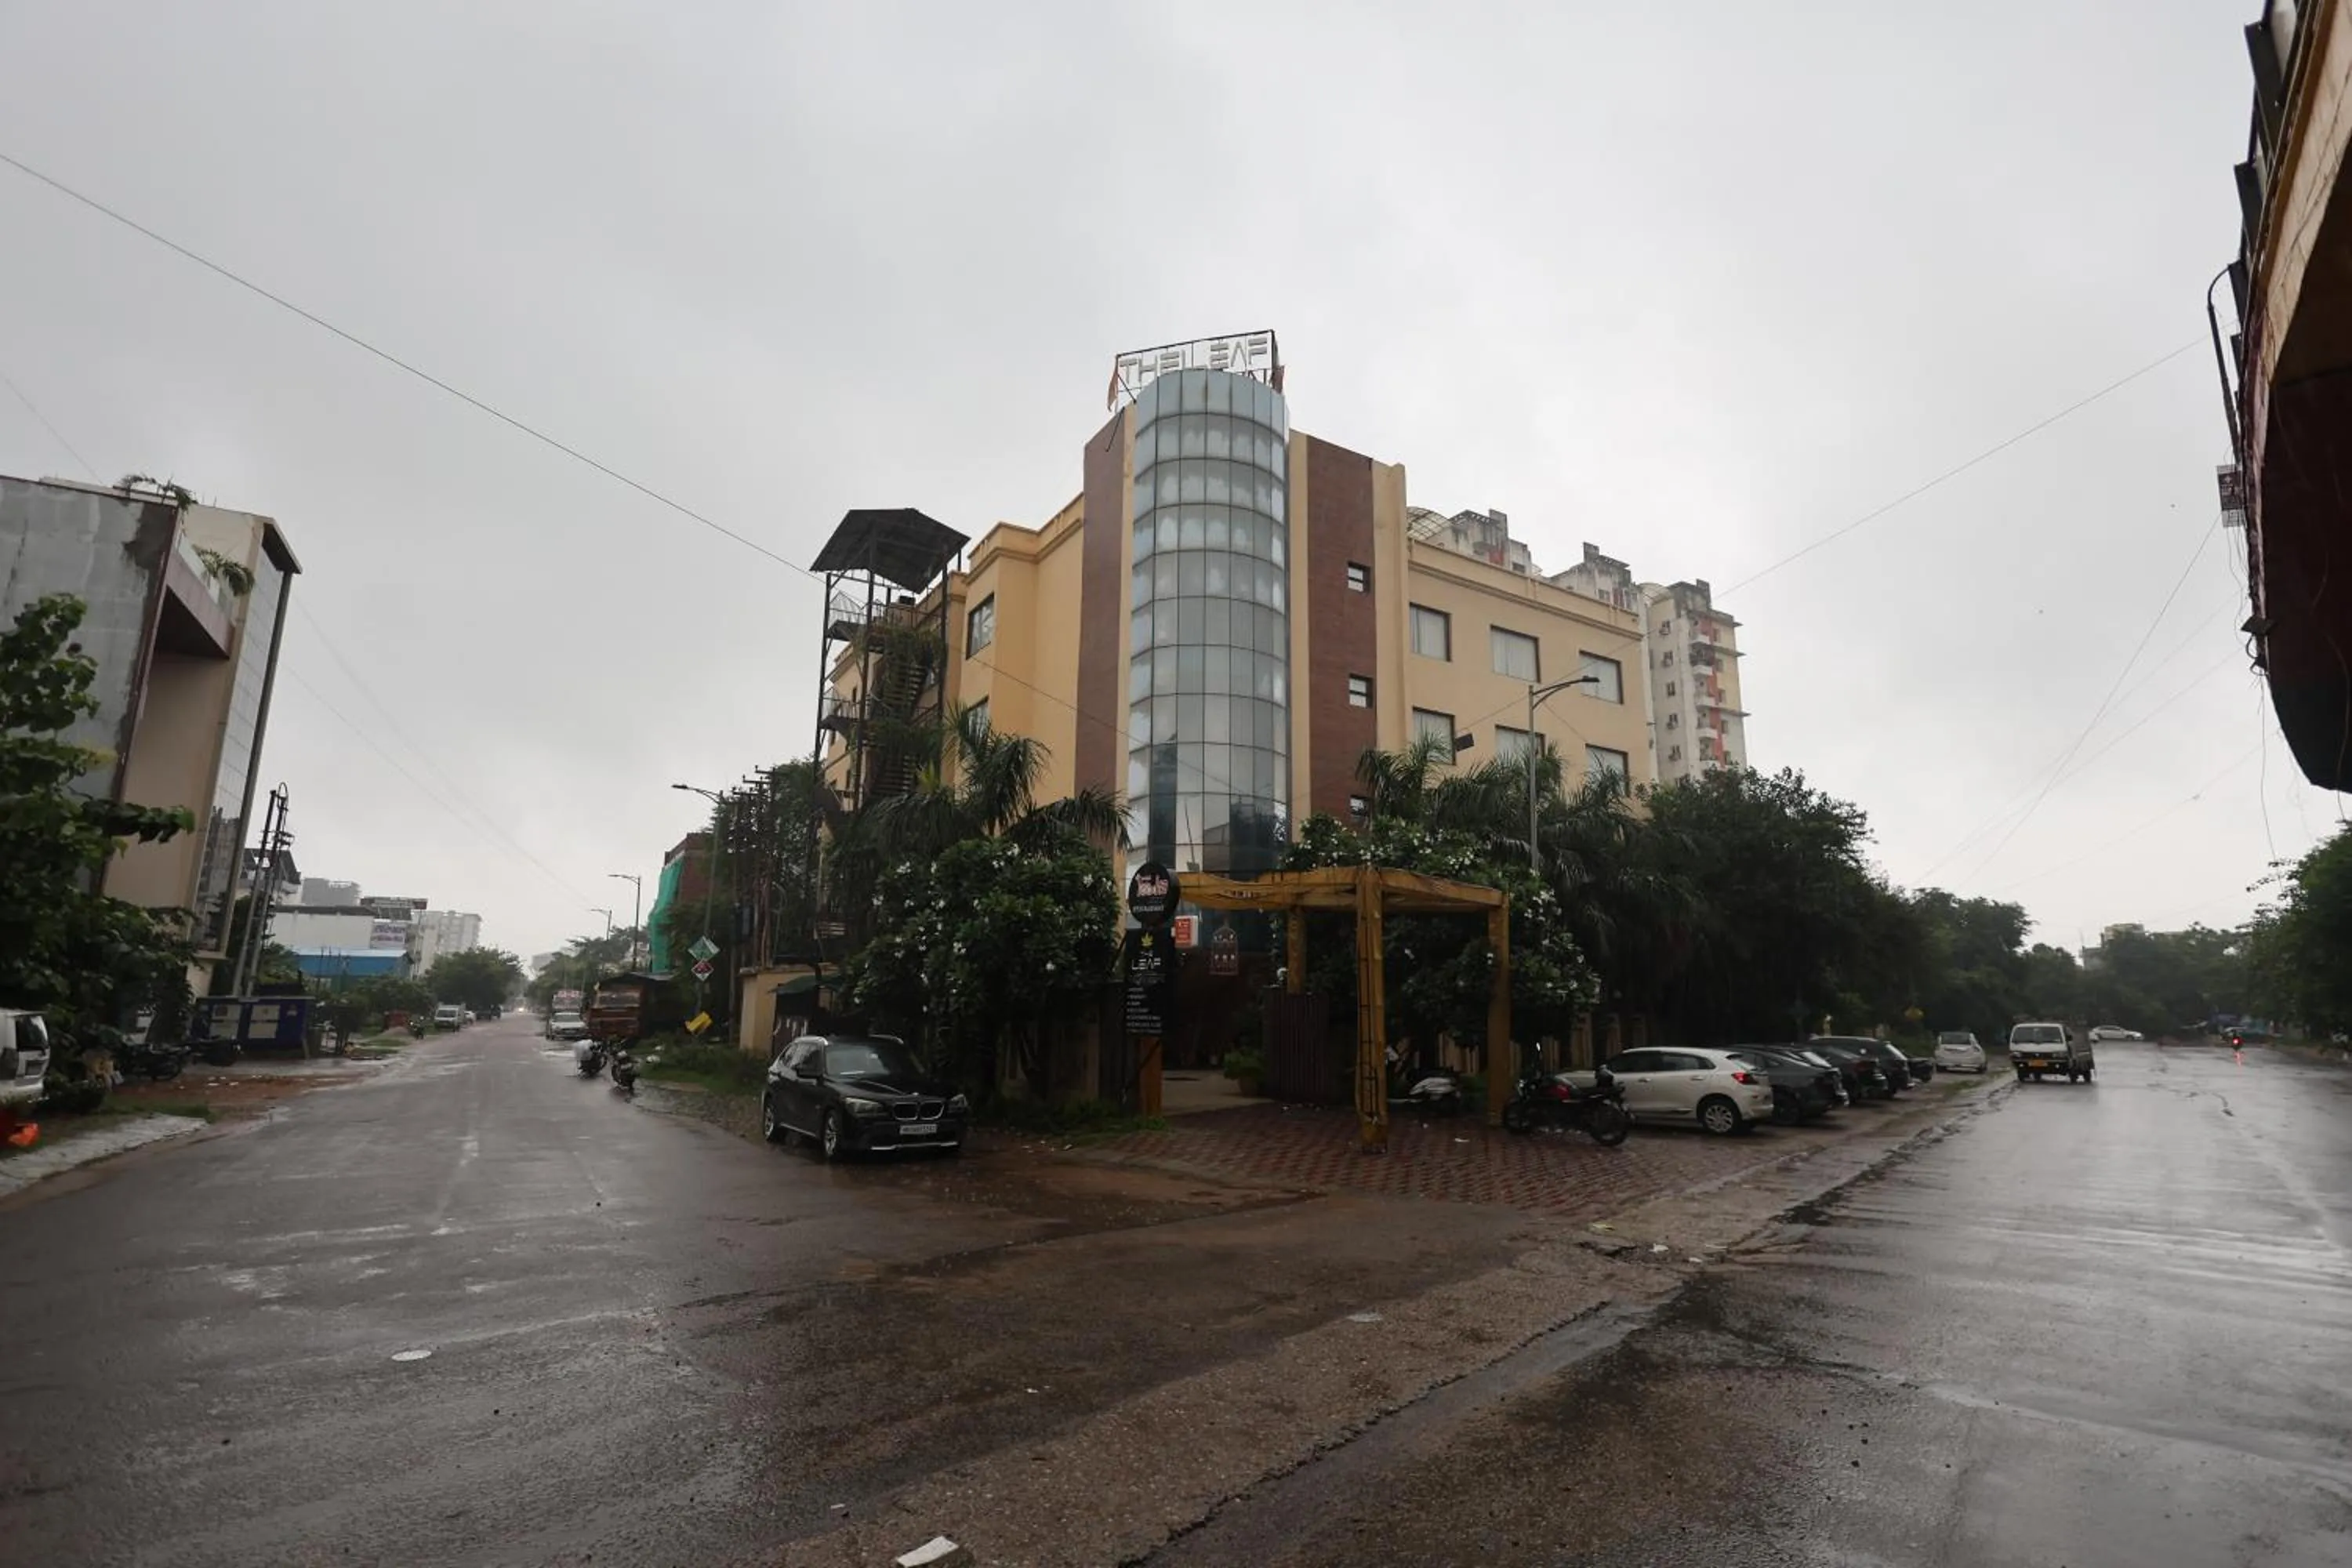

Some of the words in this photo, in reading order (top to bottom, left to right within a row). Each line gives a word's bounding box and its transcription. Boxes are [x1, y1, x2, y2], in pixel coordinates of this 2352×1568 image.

[1119, 350, 1180, 385] THE
[1181, 337, 1268, 370] LEAF
[1131, 957, 1161, 970] LEAF
